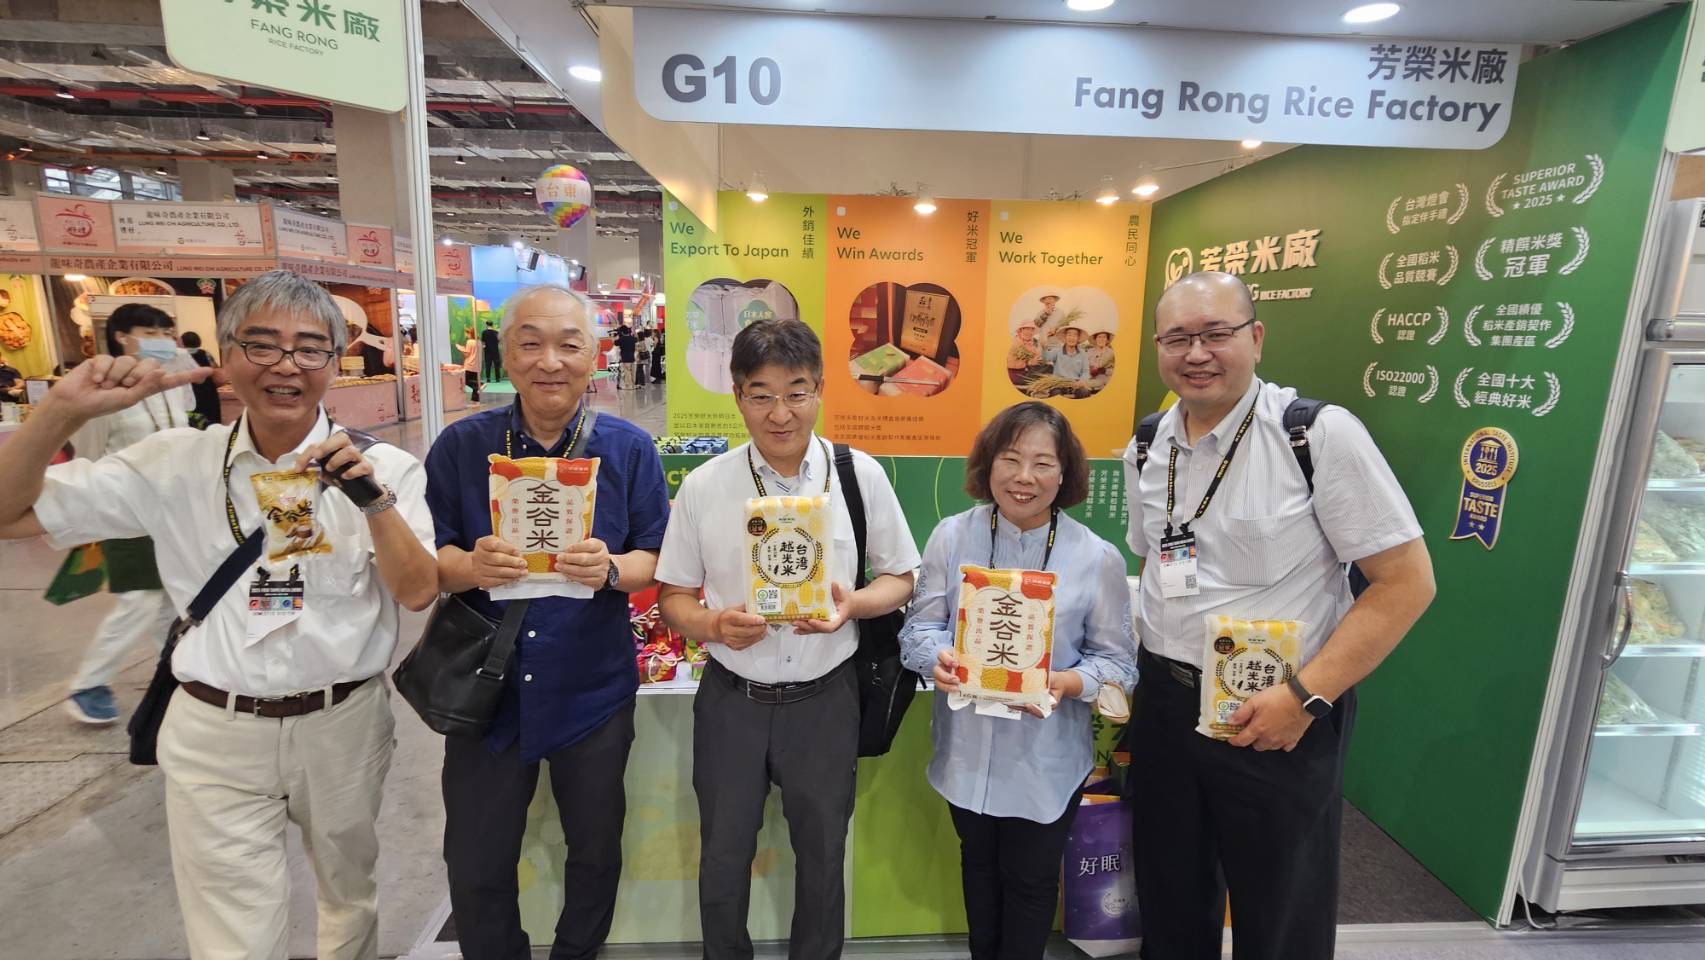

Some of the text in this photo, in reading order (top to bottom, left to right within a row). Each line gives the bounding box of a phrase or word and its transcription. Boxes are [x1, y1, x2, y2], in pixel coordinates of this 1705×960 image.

[225, 0, 382, 42] 榮米廠
[251, 18, 339, 50] FANG RONG
[268, 37, 324, 56] RICE FACTORY
[1366, 43, 1508, 85] 芳榮米廠
[661, 53, 782, 106] G10
[1073, 77, 1503, 133] Fang Rong Rice Factory
[1513, 162, 1576, 185] SUPERIOR
[1501, 174, 1585, 200] TASTE AWARD
[1523, 194, 1553, 209] 2025
[669, 222, 695, 235] We
[837, 226, 861, 240] We
[966, 210, 979, 263] 好米冠軍
[1000, 231, 1023, 244] We
[671, 242, 789, 259] Export To Japan
[1125, 214, 1140, 267] 農民同心
[1199, 229, 1322, 275] 芳榮米廠
[837, 247, 924, 262] Win Awards
[999, 251, 1104, 267] Work Together
[1396, 250, 1440, 269] 全國稻米
[1503, 253, 1551, 278] 冠軍
[1387, 312, 1432, 327] HACCP
[1376, 369, 1425, 385] ISO22000
[1477, 371, 1536, 390] 全國十大
[1473, 390, 1532, 409] 經典好米
[1475, 462, 1498, 476] 2025
[526, 483, 560, 548] 金谷米
[1463, 497, 1499, 518] TASTE
[779, 540, 797, 576] 越光米
[795, 543, 808, 571] 台湾
[986, 594, 1023, 665] 金谷米
[1244, 660, 1263, 692] 越光米
[1078, 853, 1120, 877] 好眠
